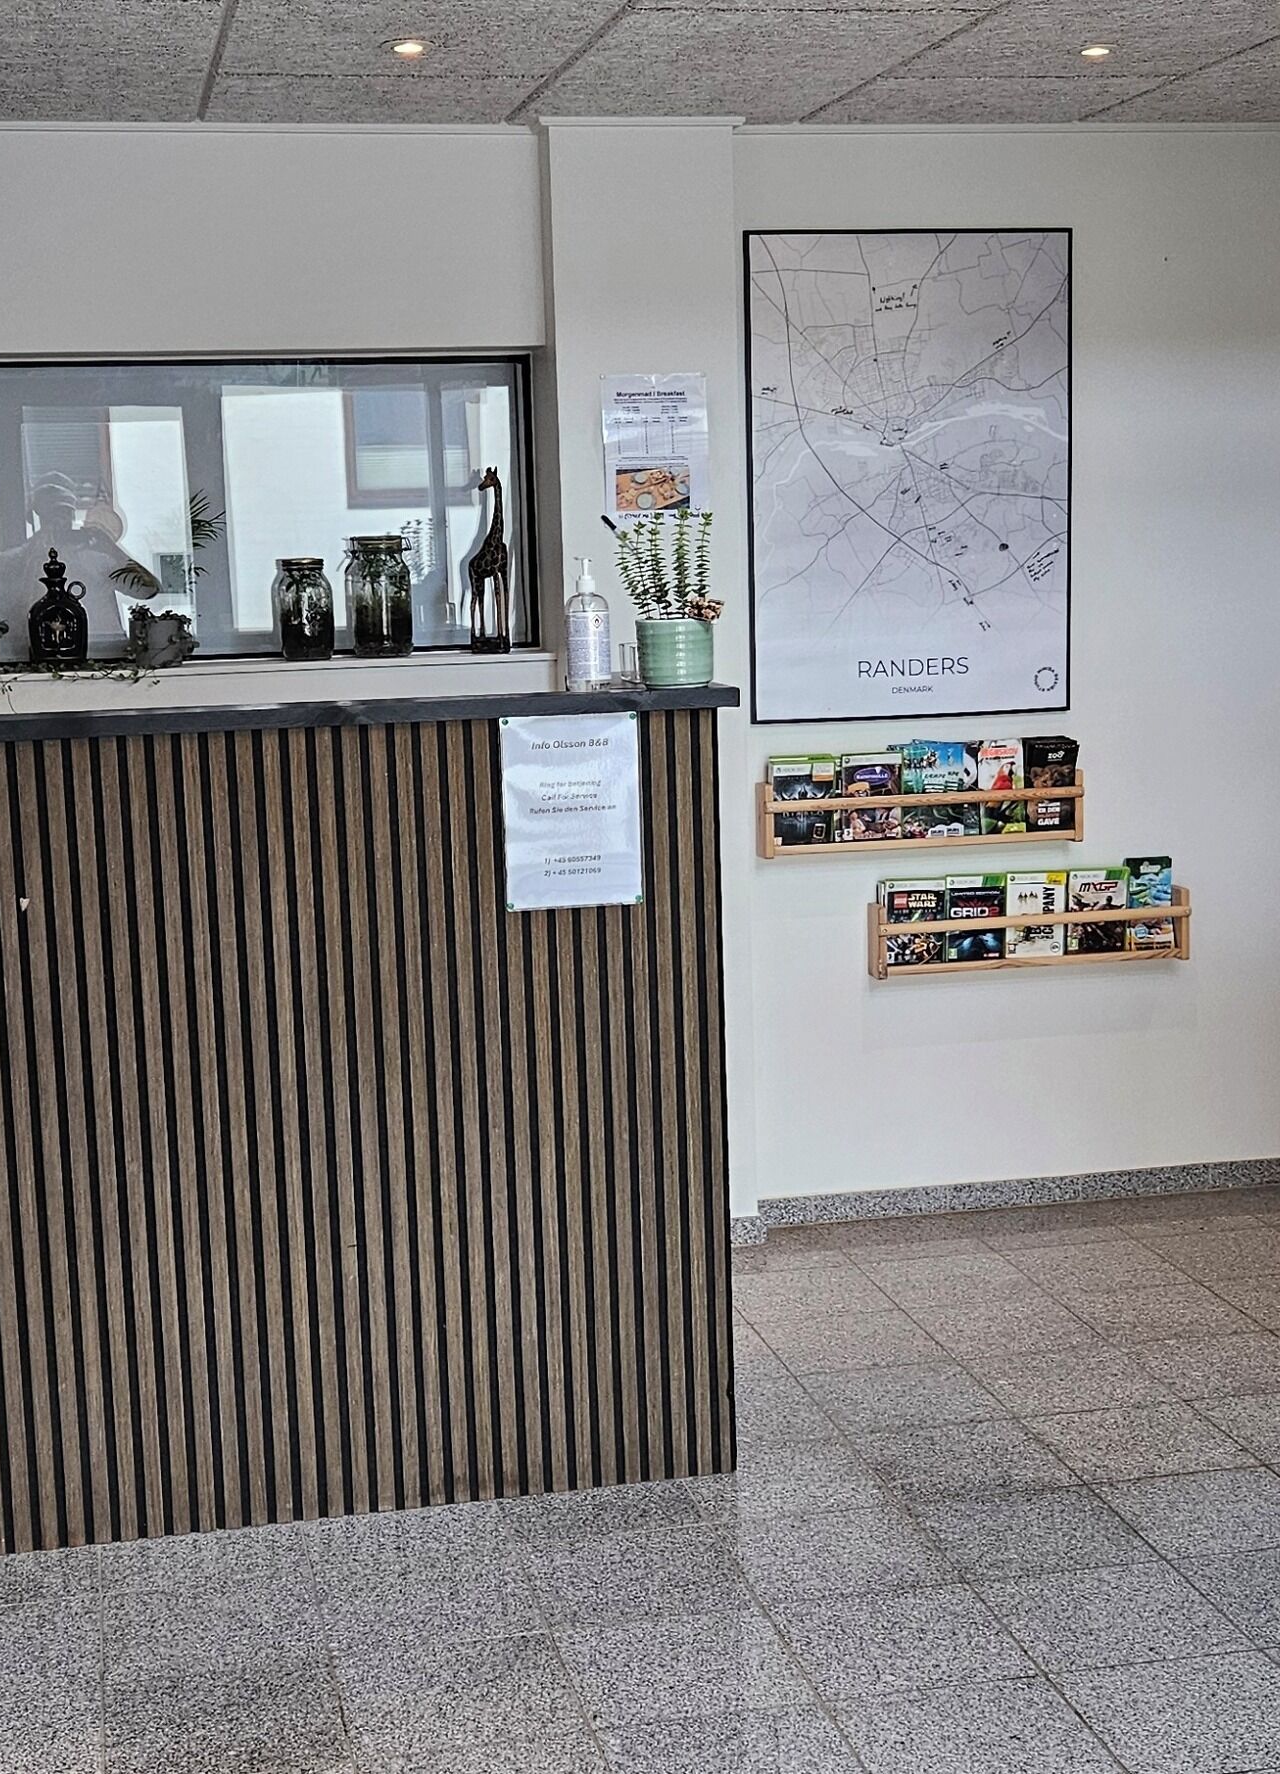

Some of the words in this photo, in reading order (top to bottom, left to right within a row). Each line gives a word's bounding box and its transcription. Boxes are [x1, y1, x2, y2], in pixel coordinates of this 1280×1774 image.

[858, 657, 969, 678] RANDERS
[891, 685, 934, 694] DENMARK
[531, 741, 551, 750] Info
[553, 740, 586, 748] Olsson
[588, 738, 608, 747] B&B
[1078, 881, 1118, 893] MXGP
[908, 892, 937, 901] STAR
[1042, 887, 1055, 935] CPANY
